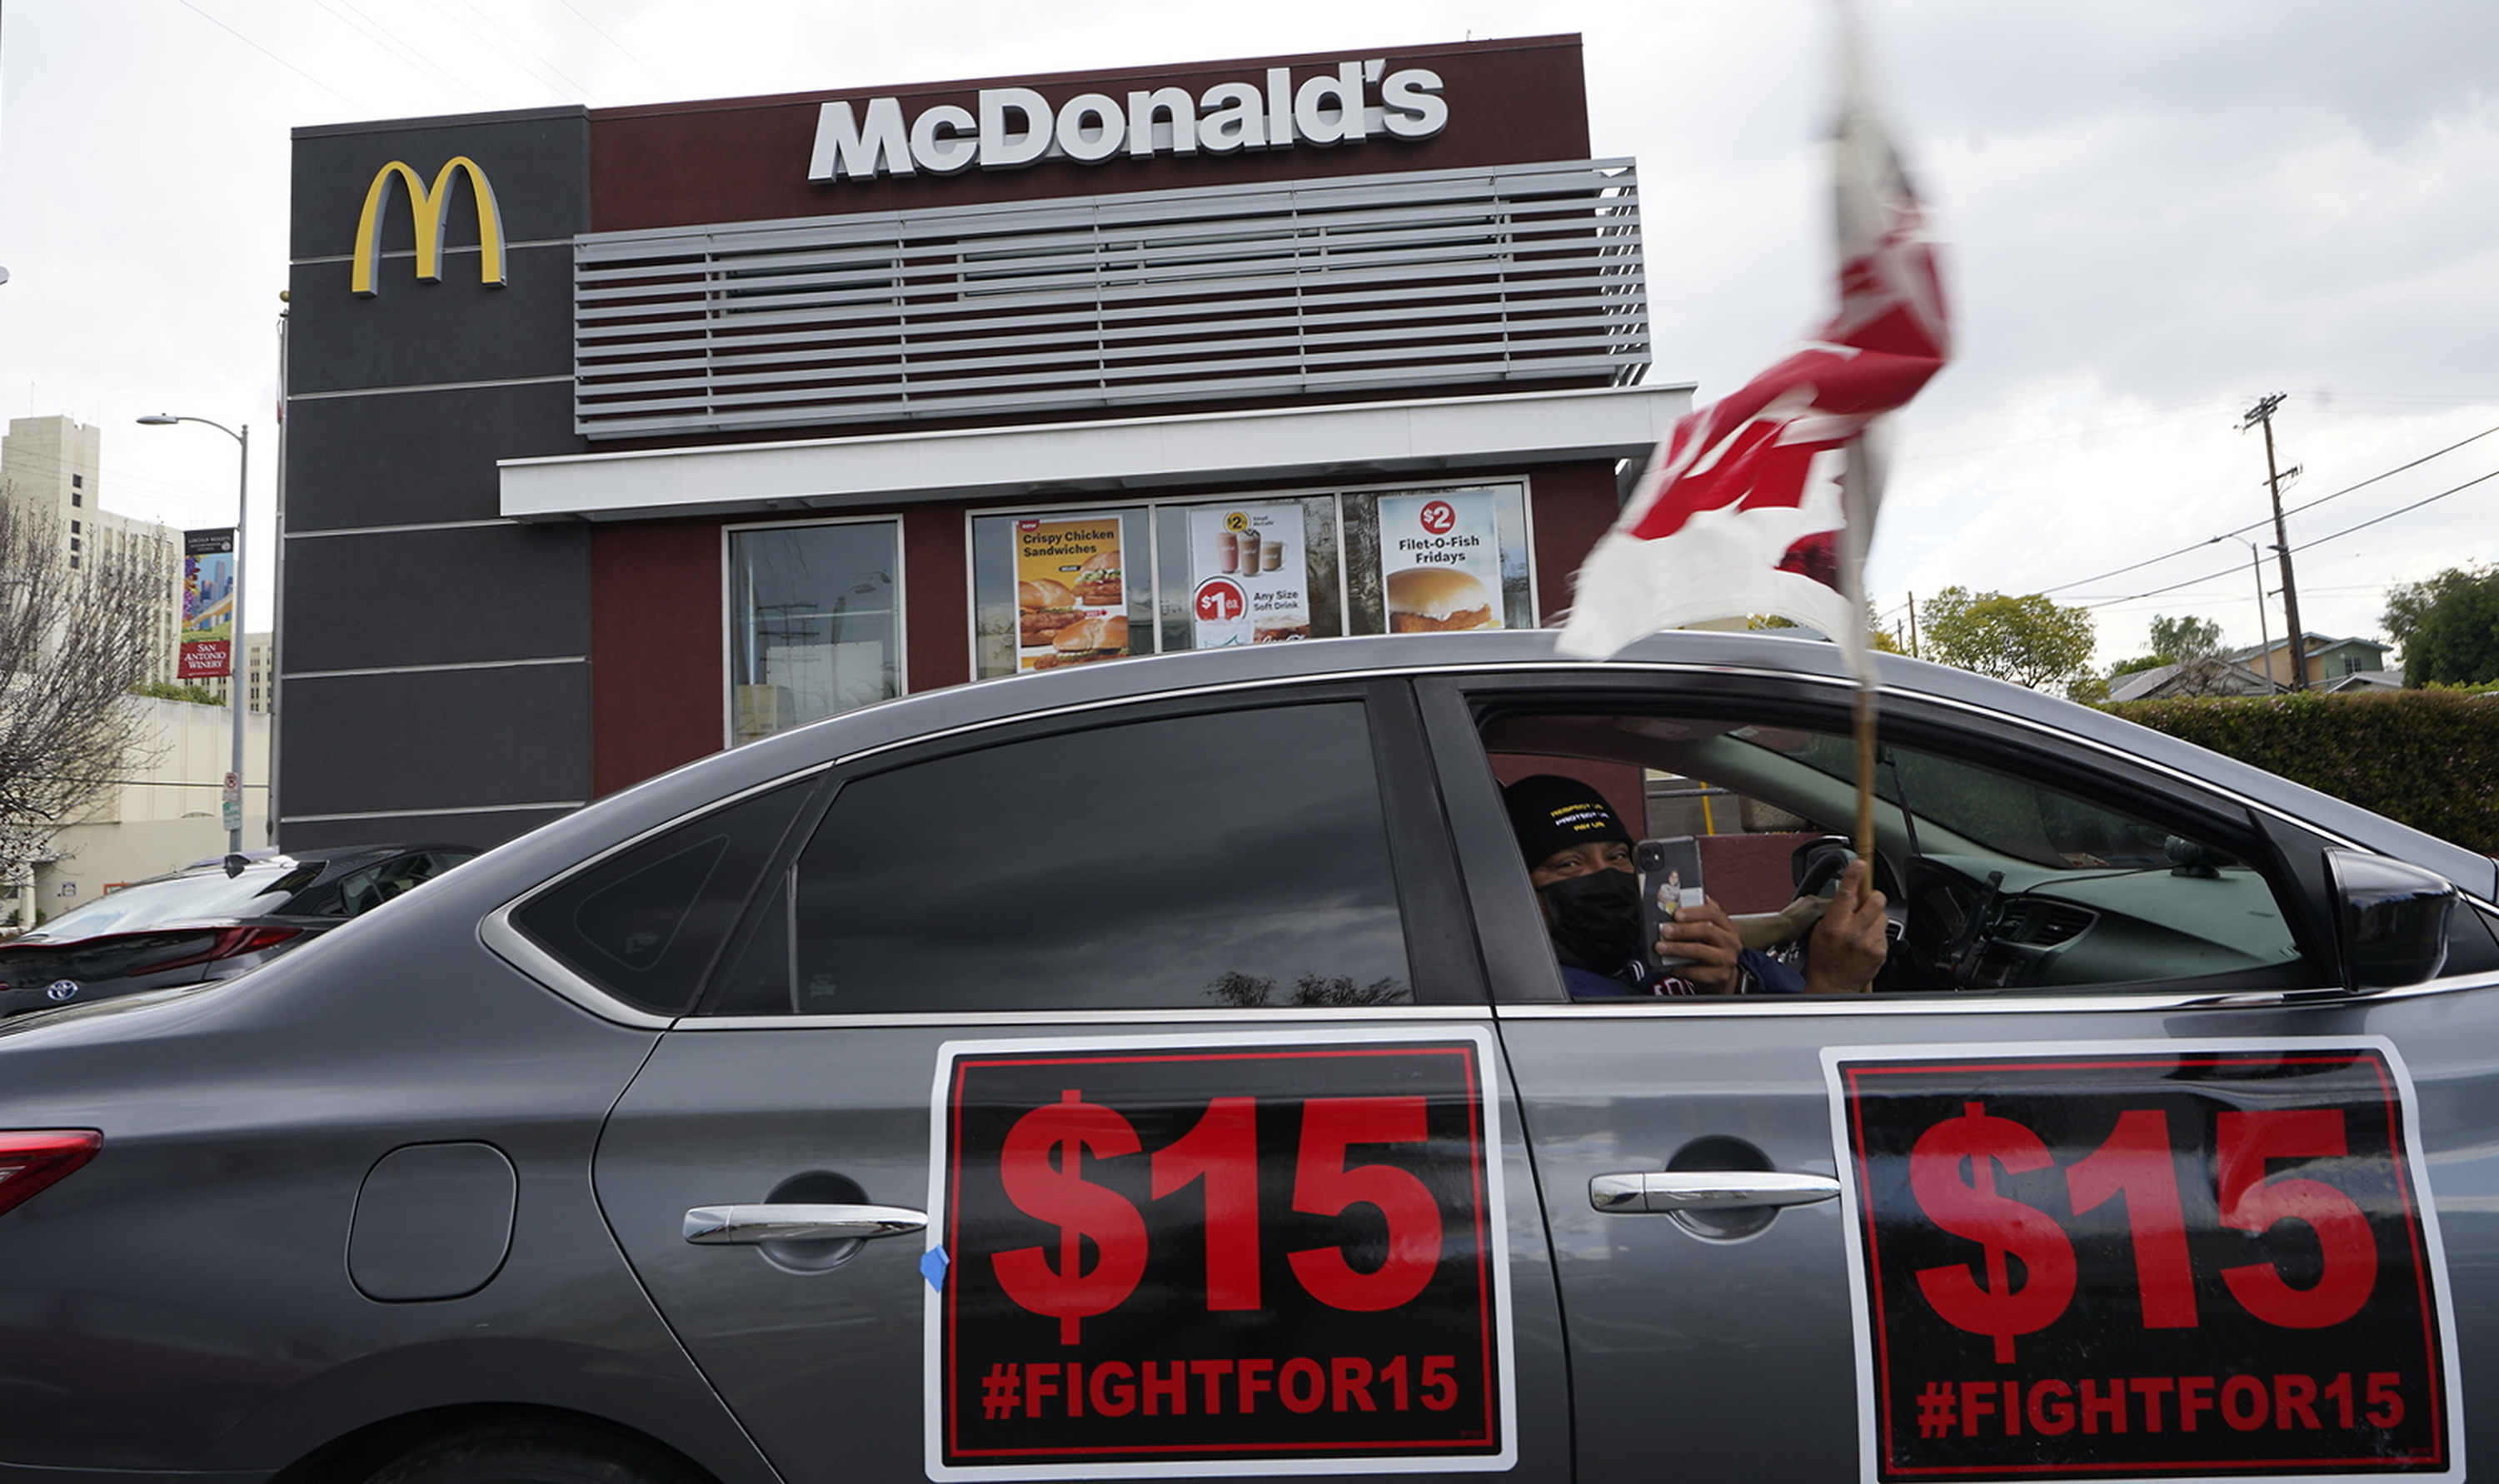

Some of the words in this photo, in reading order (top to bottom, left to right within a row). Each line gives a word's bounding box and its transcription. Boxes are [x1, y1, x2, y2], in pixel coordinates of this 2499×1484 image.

[808, 59, 1449, 183] McDonald's
[1424, 507, 1450, 529] $2
[1024, 533, 1062, 545] Crispy
[1065, 530, 1115, 542] Chicken
[1399, 535, 1479, 550] Filet-O-Fish
[1024, 544, 1097, 557] Sandwiches
[1416, 551, 1466, 565] Fridays
[1254, 592, 1274, 601] Any
[1276, 590, 1299, 600] Size
[1254, 603, 1273, 611] Soft
[1274, 600, 1299, 610] Drink
[197, 644, 217, 652] SAN
[184, 651, 227, 662] ANTONIO
[187, 660, 222, 669] WINERY
[991, 1089, 1442, 1345] $15
[1909, 1101, 2378, 1364] $15
[982, 1355, 1458, 1419] #FIGHTFOR15
[1916, 1372, 2405, 1438] #FIGHTFOR15
